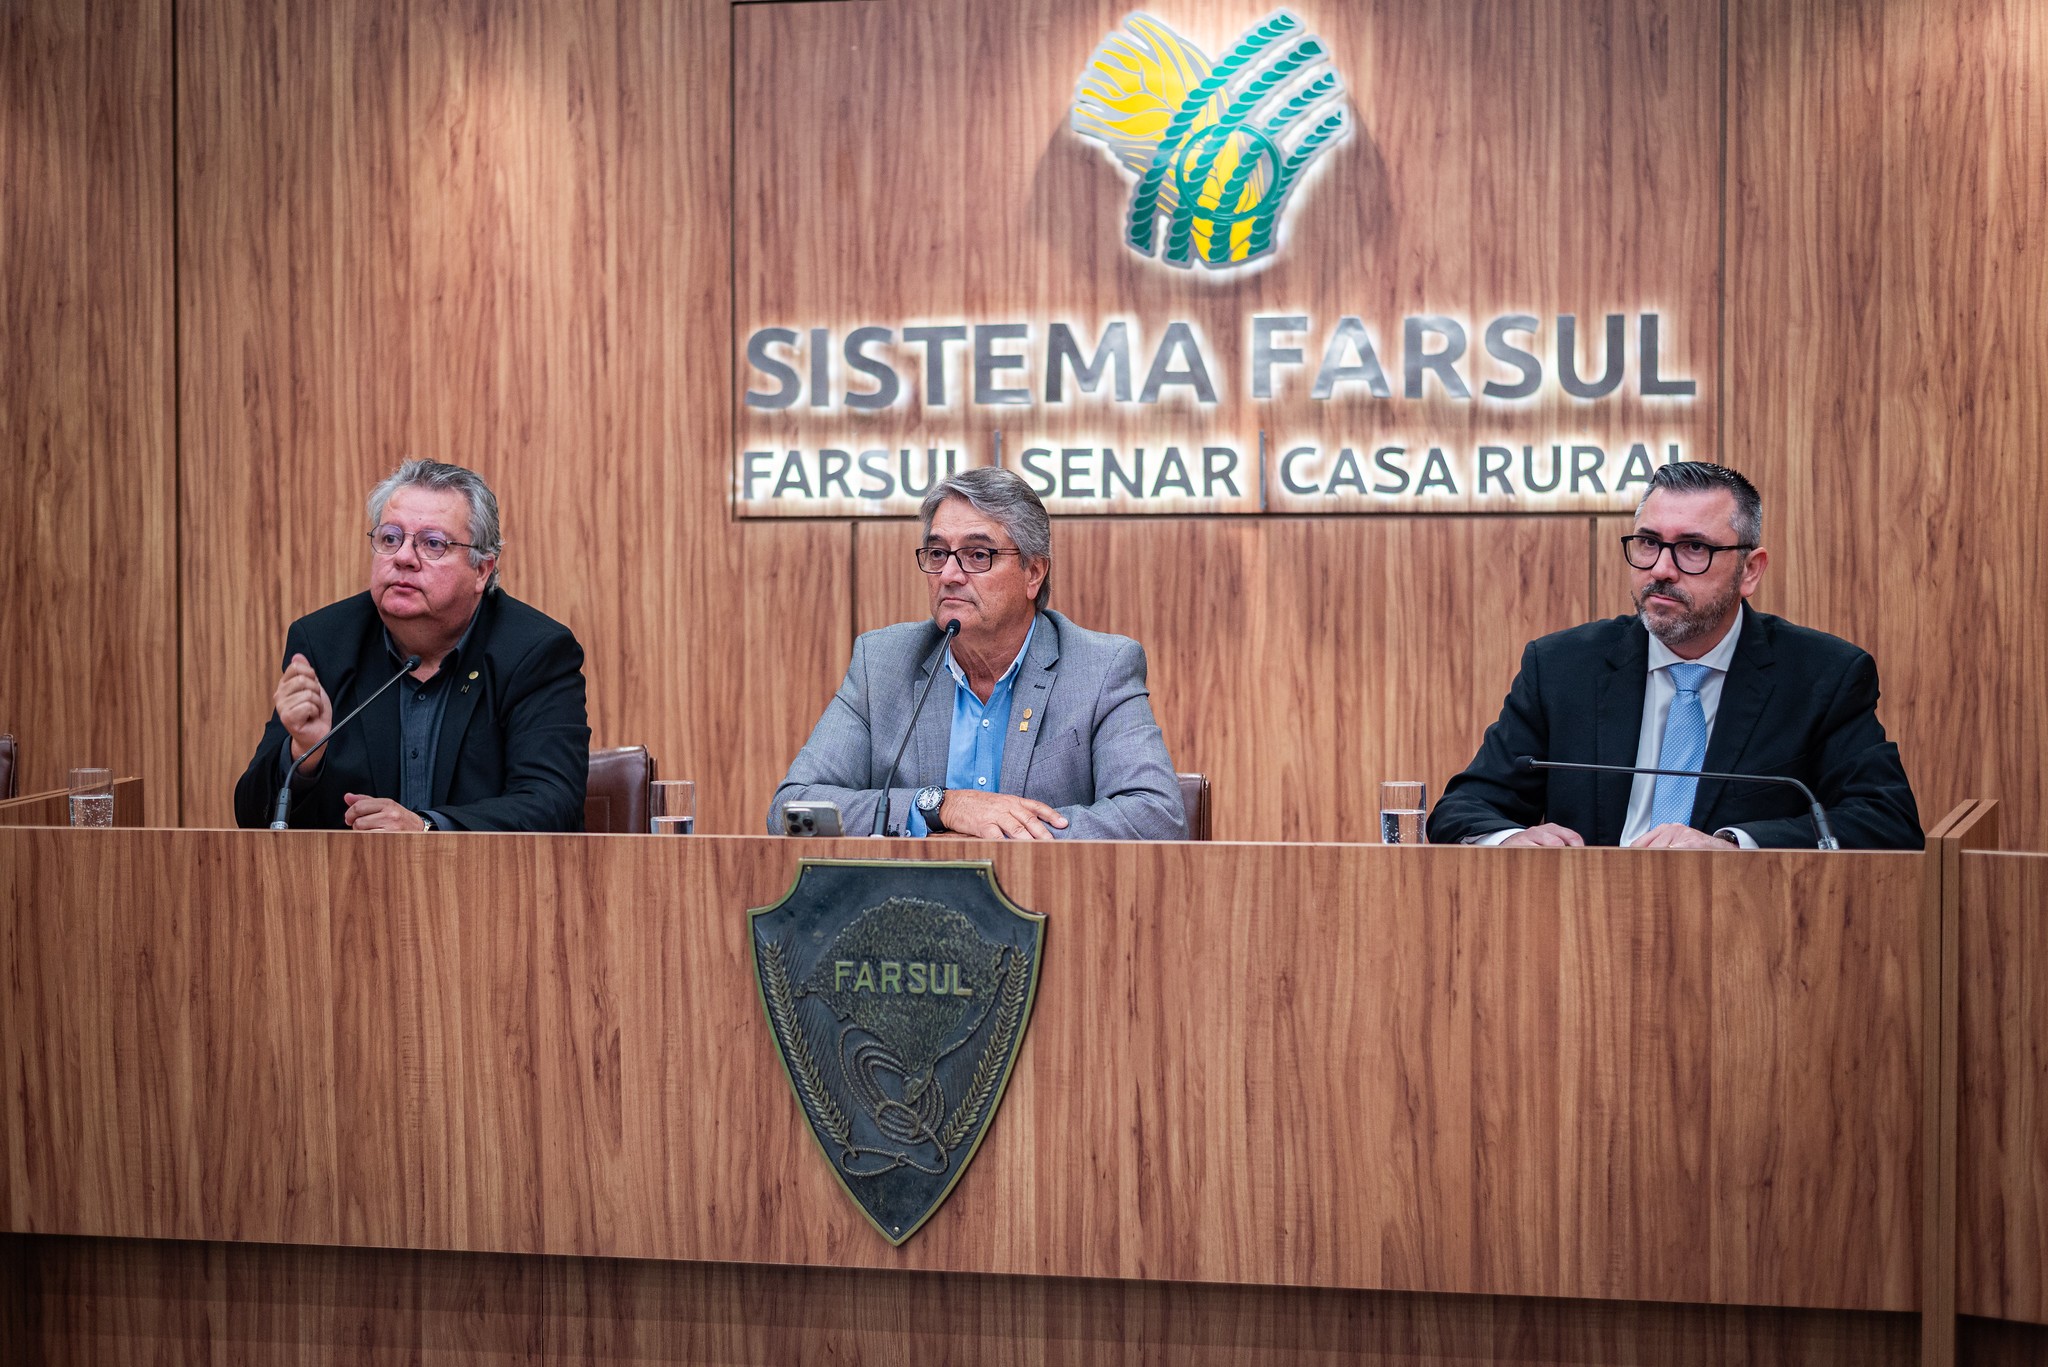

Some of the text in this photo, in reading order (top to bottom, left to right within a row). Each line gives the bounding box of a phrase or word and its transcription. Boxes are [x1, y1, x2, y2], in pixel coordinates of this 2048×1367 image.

[745, 313, 1697, 408] SISTEMA FARSUL
[1021, 446, 1241, 498] SENAR
[1280, 446, 1459, 495] CASA
[1478, 443, 1679, 495] RURA
[834, 960, 973, 996] FARSUL
